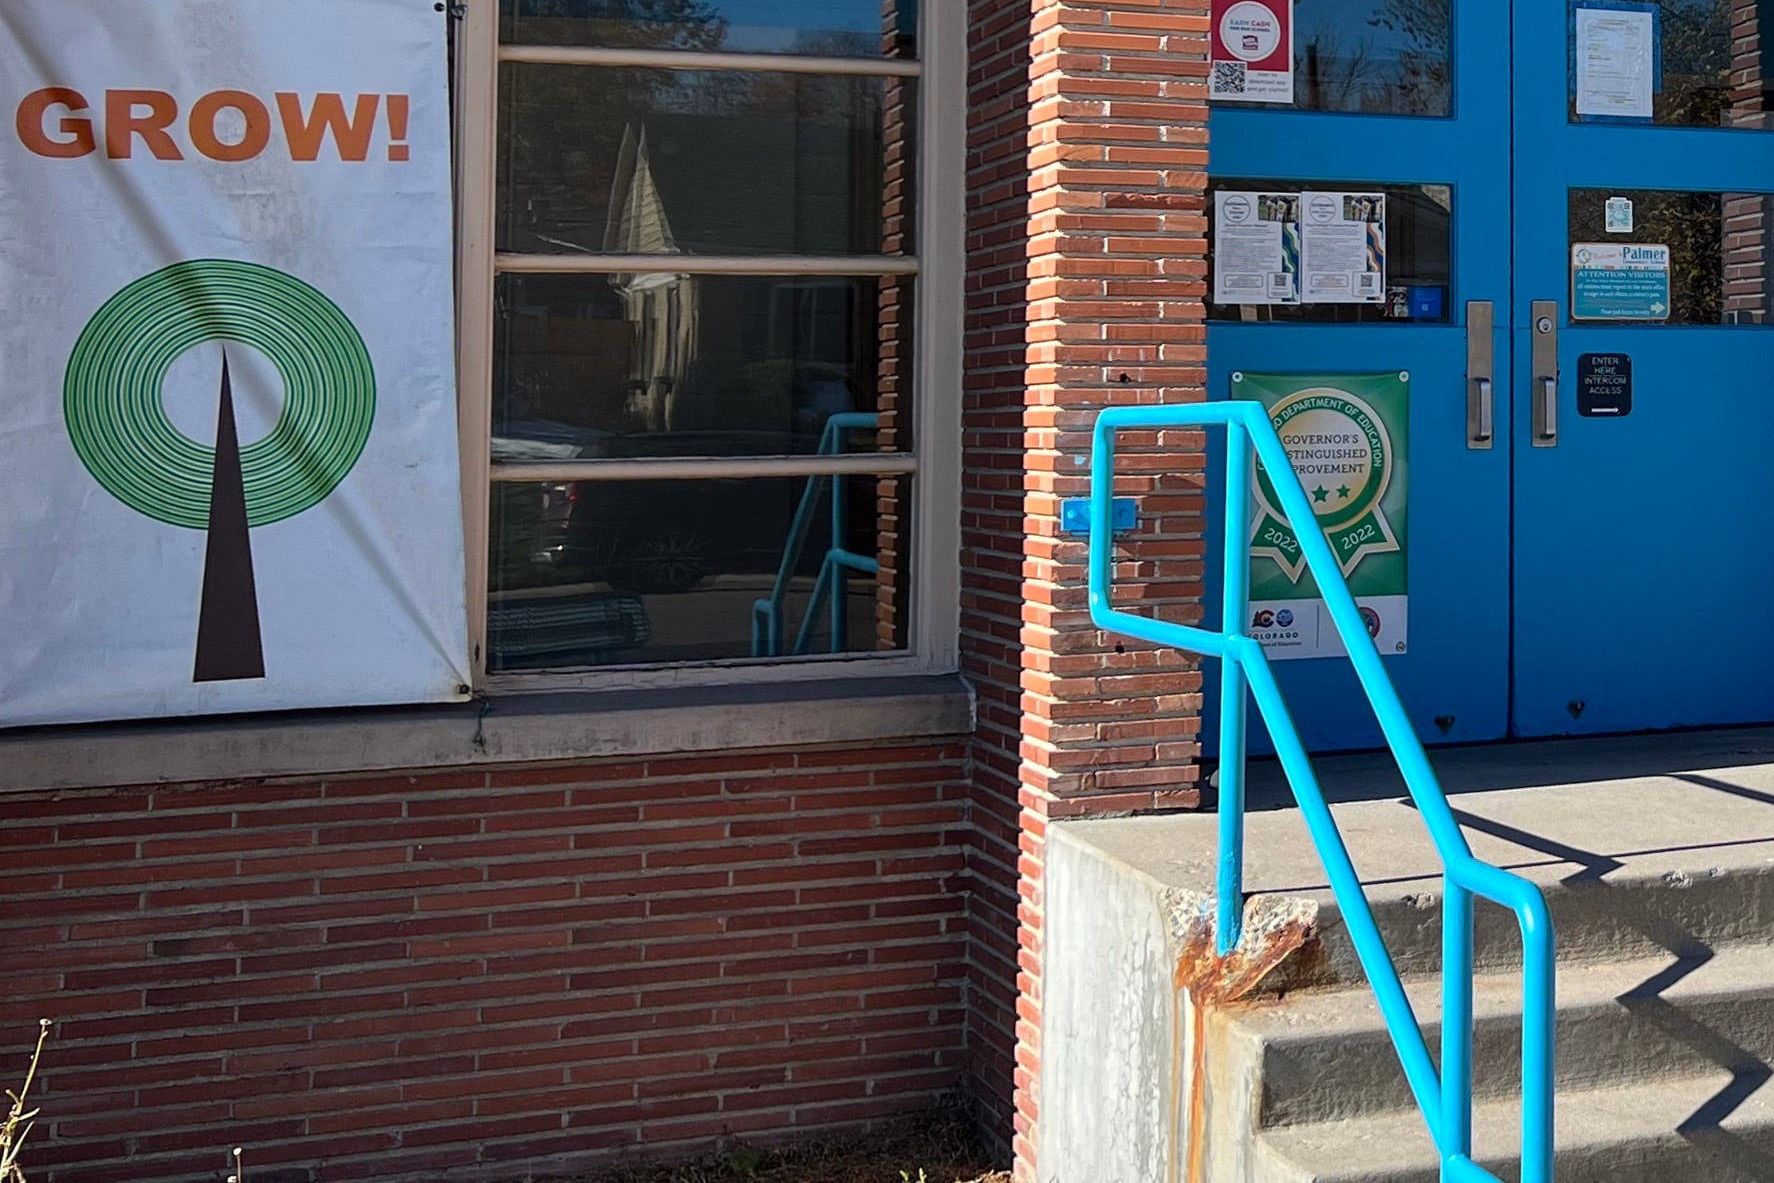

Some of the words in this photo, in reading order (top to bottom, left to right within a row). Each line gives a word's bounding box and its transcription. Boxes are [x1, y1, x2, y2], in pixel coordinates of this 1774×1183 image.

[1250, 19, 1271, 27] CASH
[15, 88, 411, 163] GROW!
[1623, 246, 1666, 260] Palmer
[1628, 271, 1666, 279] VISITORS
[1591, 356, 1619, 366] ENTER
[1594, 366, 1617, 375] HERE
[1584, 376, 1627, 385] INTERCOM
[1589, 386, 1623, 395] ACCESS
[1282, 397, 1345, 421] DEPARTMENT
[1344, 404, 1360, 417] OF
[1356, 413, 1384, 468] EDUCATION
[1283, 434, 1360, 445] GOVERNOR'S
[1288, 448, 1368, 460] STINGUISHED
[1293, 463, 1365, 476] PROVEMENT
[1264, 527, 1299, 554] 2022
[1341, 524, 1376, 551] 2022
